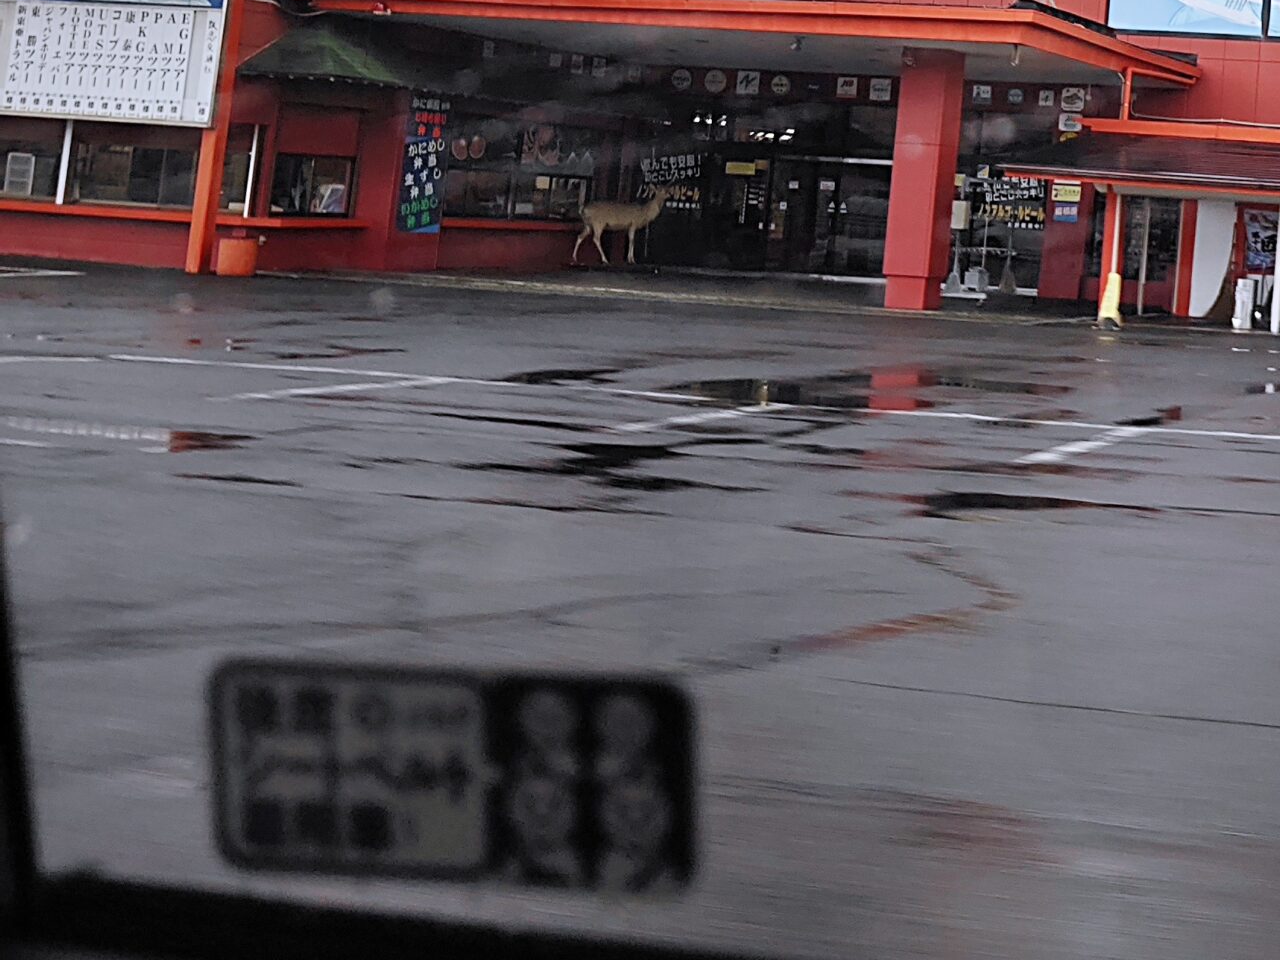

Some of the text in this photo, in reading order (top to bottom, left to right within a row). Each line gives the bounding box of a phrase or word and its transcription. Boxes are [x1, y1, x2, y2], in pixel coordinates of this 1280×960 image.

[64, 7, 80, 86] LOTTEツアー
[77, 8, 95, 86] MODEツアー
[91, 9, 109, 87] UTSツアー
[106, 10, 122, 88] コープツアー
[133, 11, 149, 90] PKGツアー
[174, 13, 190, 92] EGLツアー
[408, 139, 445, 156] かにめし
[414, 154, 437, 170] 弁当
[410, 182, 433, 199] 弁当
